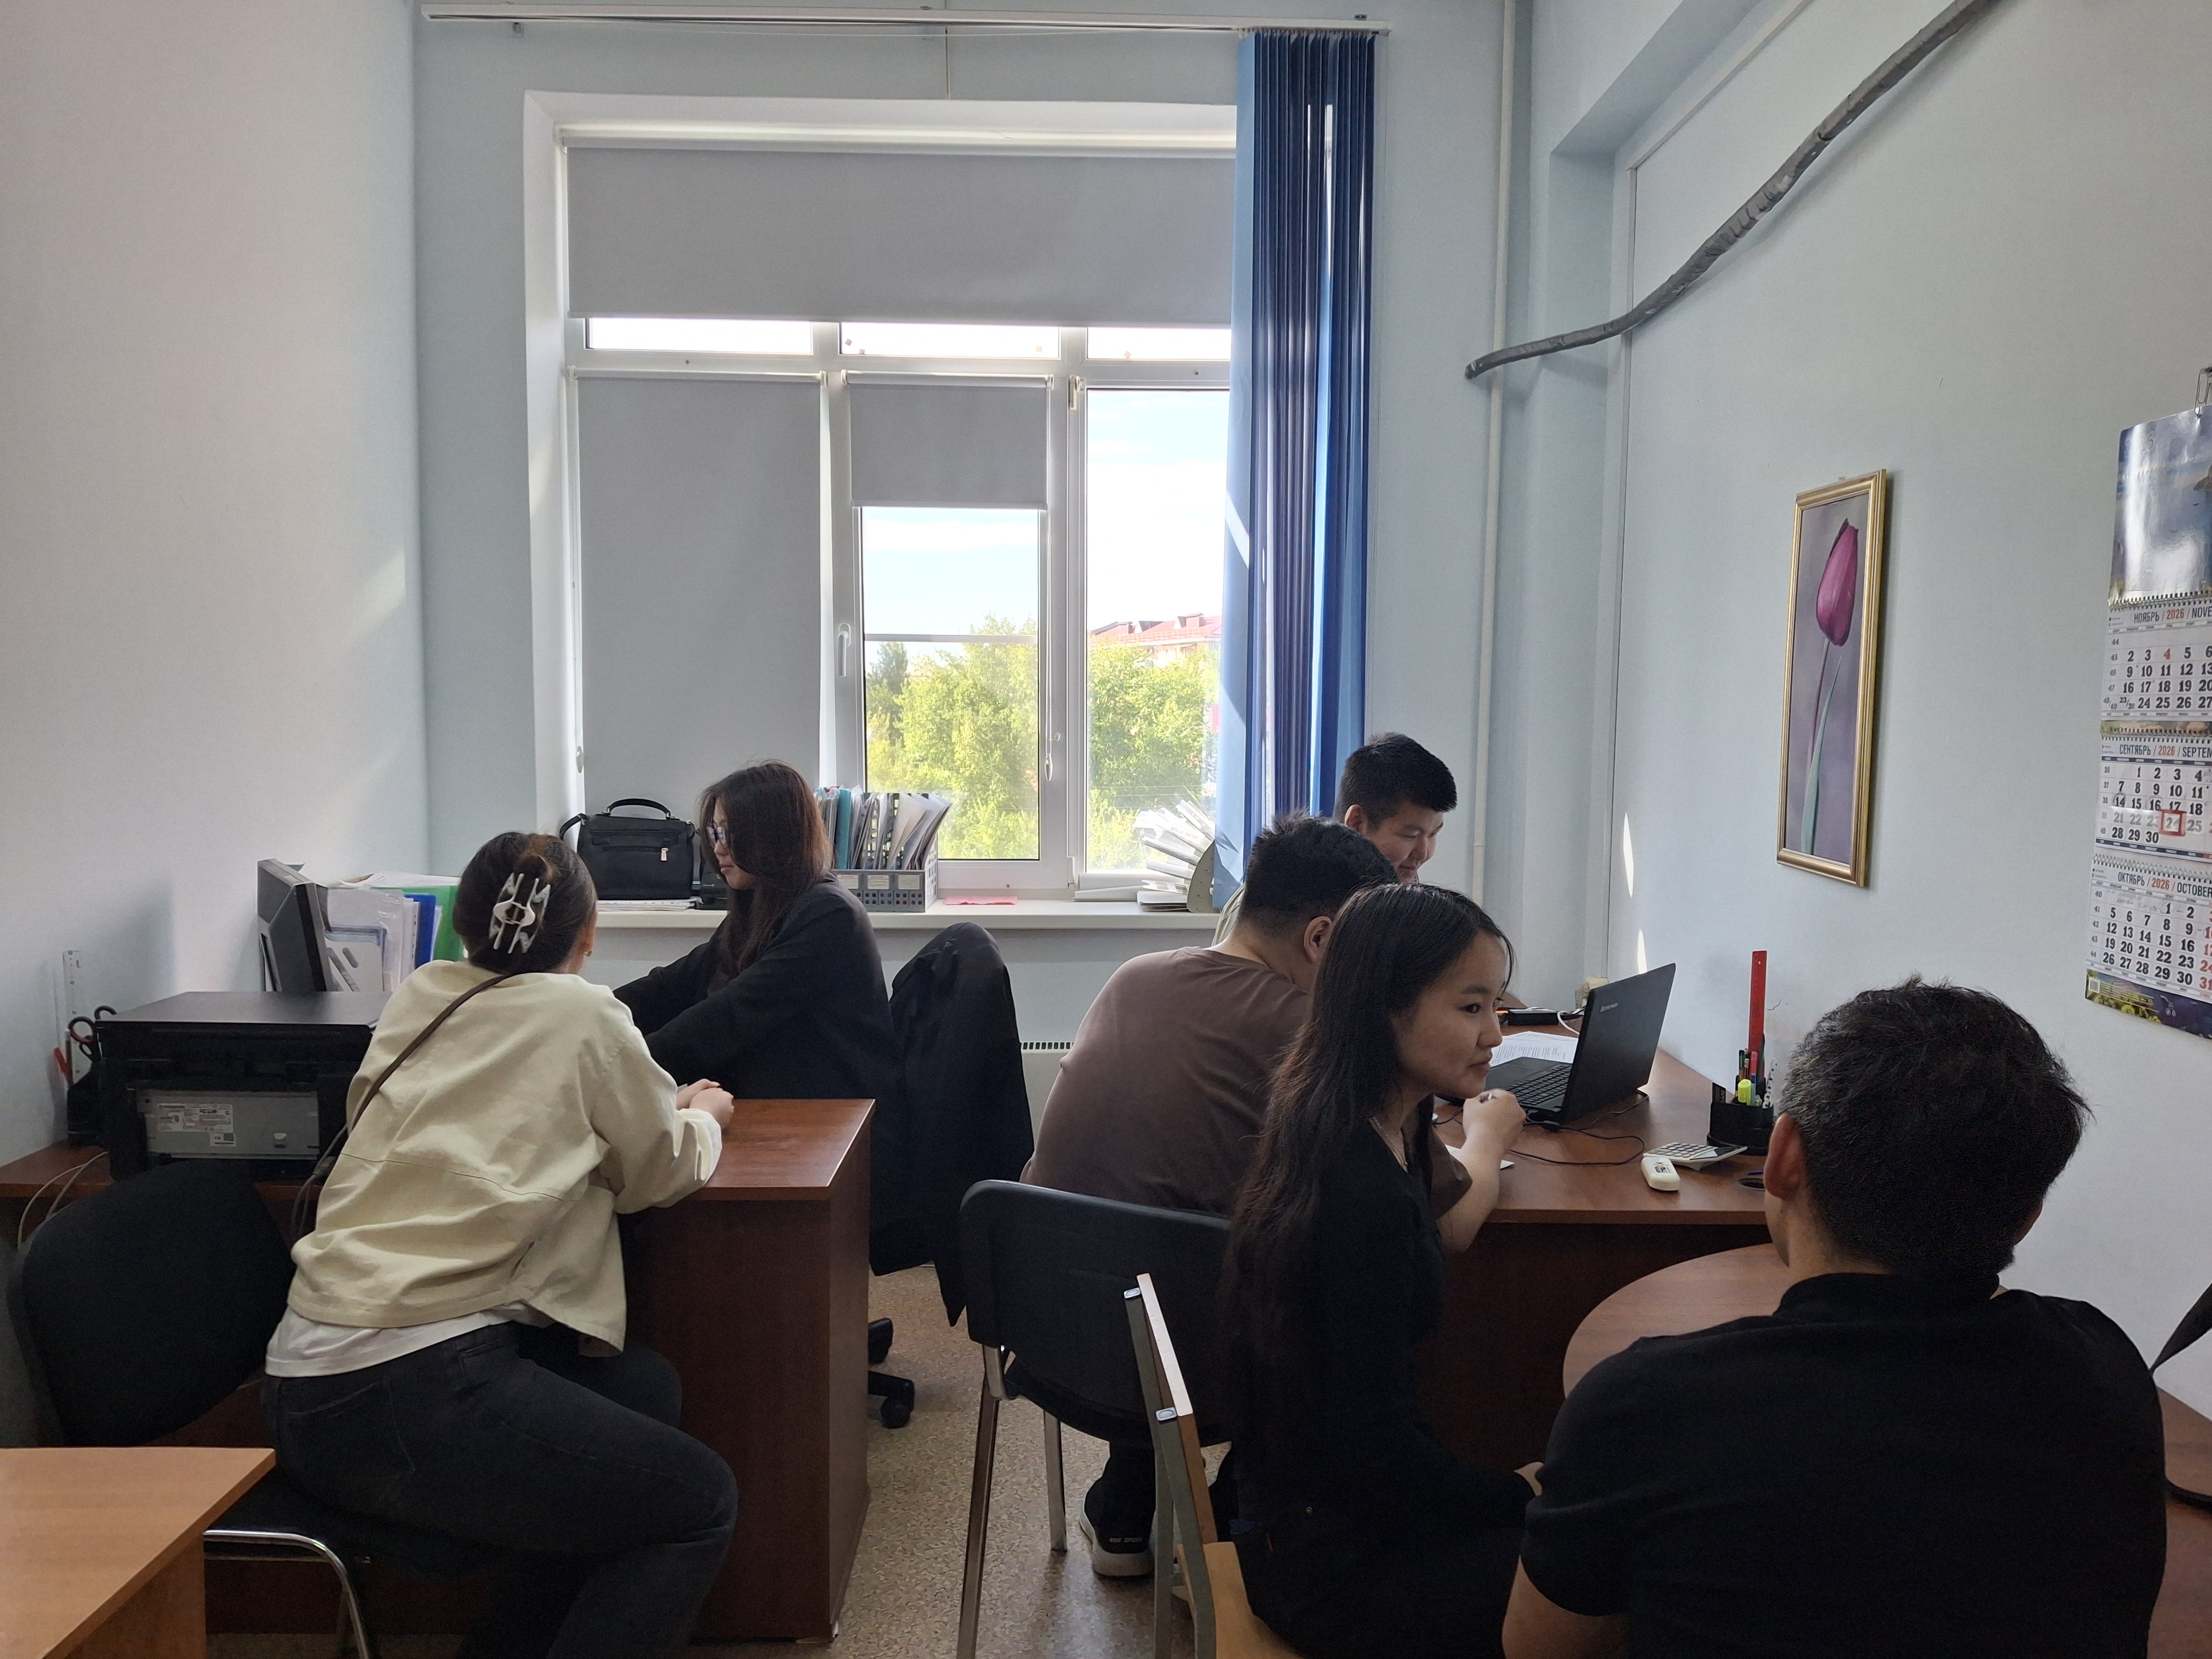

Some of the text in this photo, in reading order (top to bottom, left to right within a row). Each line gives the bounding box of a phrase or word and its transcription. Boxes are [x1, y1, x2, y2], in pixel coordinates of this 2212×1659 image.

[2134, 611, 2160, 624] НОЯБРЬ
[2166, 608, 2185, 620] 2026
[2127, 650, 2134, 662] 2
[2144, 649, 2152, 661] 3
[2163, 647, 2171, 660] 4
[2184, 646, 2191, 659] 5
[2205, 645, 2212, 658] 6
[2109, 662, 2212, 678] 46 9 10 11 12 13
[2123, 681, 2134, 693] 16
[2140, 681, 2152, 693] 17
[2158, 680, 2171, 692] 18
[2179, 679, 2192, 692] 19
[2198, 679, 2212, 692] 20
[2138, 697, 2151, 709] 24
[2155, 696, 2171, 709] 25
[2176, 696, 2192, 709] 26
[2198, 696, 2212, 709] 27
[2119, 744, 2151, 756] СЕНТЯБРЬ
[2158, 745, 2176, 756] 2026
[2137, 766, 2141, 778] 1
[2153, 767, 2161, 779] 2
[2174, 768, 2181, 781] 3
[2194, 769, 2203, 782] 4
[2118, 781, 2125, 792] 7
[2134, 782, 2141, 794] 8
[2153, 783, 2160, 795] 9
[2169, 785, 2183, 797] 10
[2191, 786, 2203, 799] 11
[2115, 796, 2125, 808] 14
[2131, 798, 2142, 809] 15
[2150, 799, 2162, 811] 16
[2169, 801, 2182, 811] 17
[2189, 802, 2203, 815] 18
[2113, 812, 2124, 824] 21
[2129, 813, 2142, 826] 22
[2186, 819, 2202, 833] 25
[2112, 826, 2124, 839] 28
[2128, 828, 2140, 841] 29
[2145, 831, 2159, 844] 30
[2118, 871, 2145, 886] ОКТЯБРЬ
[2151, 877, 2170, 890] 2026
[2177, 882, 2212, 898] OCTOBER
[2094, 890, 2102, 898] 40
[2165, 902, 2171, 914] 1
[2186, 906, 2195, 919] 2
[2094, 905, 2212, 938] 41 5 6 7 8 9 1
[2106, 922, 2117, 934] 12
[2123, 925, 2133, 938] 13
[2139, 929, 2151, 943] 14
[2158, 934, 2172, 948] 15
[2181, 938, 2195, 953] 16
[2105, 937, 2115, 949] 19
[2120, 941, 2133, 954] 20
[2138, 945, 2150, 959] 21
[2156, 950, 2172, 964] 22
[2178, 955, 2195, 969] 23
[2090, 950, 2212, 991] 44 26 27 28 29 30 31
